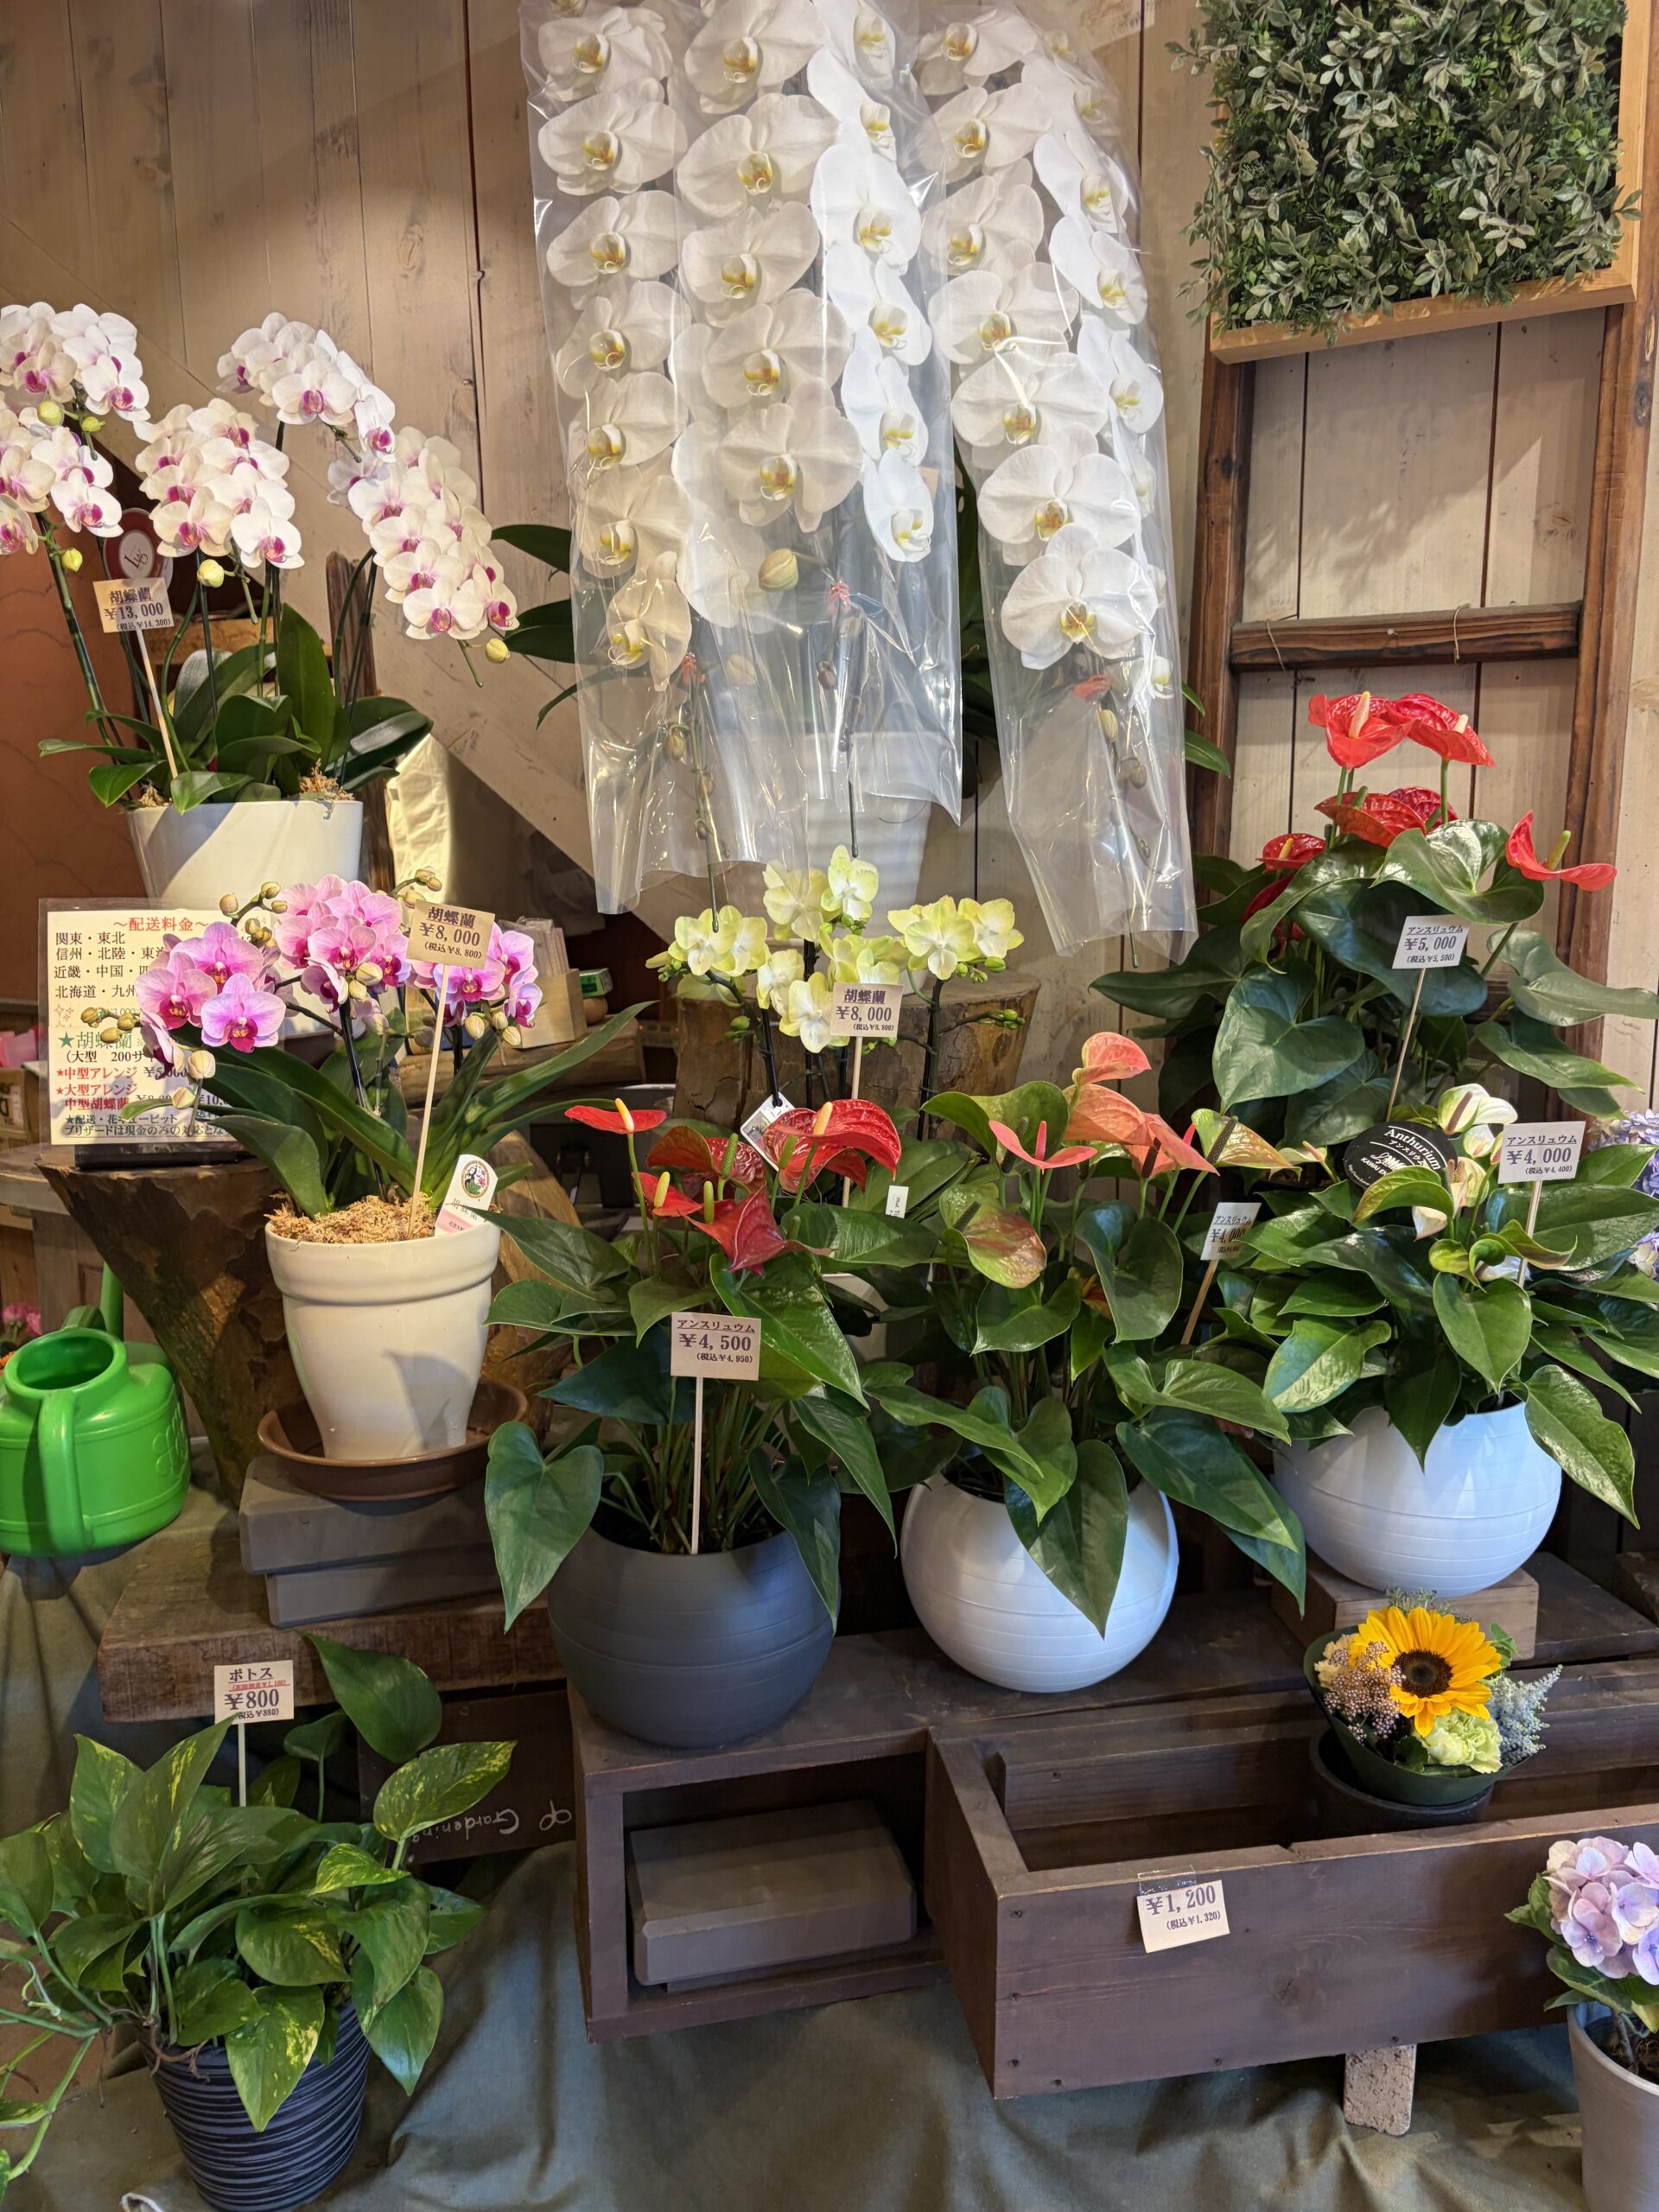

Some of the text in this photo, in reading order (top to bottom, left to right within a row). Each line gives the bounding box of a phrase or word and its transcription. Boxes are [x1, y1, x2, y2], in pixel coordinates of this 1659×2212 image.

[110, 587, 151, 603] 胡蝶蘭
[428, 906, 476, 929] 胡蝶蘭
[419, 922, 480, 946] ¥8,000
[1408, 925, 1463, 935] アンスリュウム
[55, 931, 125, 946] 関東・東北
[1403, 935, 1457, 951] ¥5,000
[843, 988, 887, 1003] 胡蝶蘭
[836, 1006, 892, 1022] ¥8,000
[111, 1051, 154, 1063] 200サ
[1384, 1128, 1441, 1170] Anthurium
[1506, 1135, 1577, 1147] アンスリュウム
[1506, 1147, 1572, 1165] ¥4,000
[1214, 1215, 1251, 1224] アンスリュウム
[677, 1319, 755, 1333] アンスリュウム
[679, 1333, 752, 1351] ¥4,500
[229, 1668, 273, 1681] ポトス
[225, 1688, 279, 1710] ¥800
[238, 1708, 279, 1719] 税込¥880)
[1146, 1885, 1217, 1916] ¥1,200
